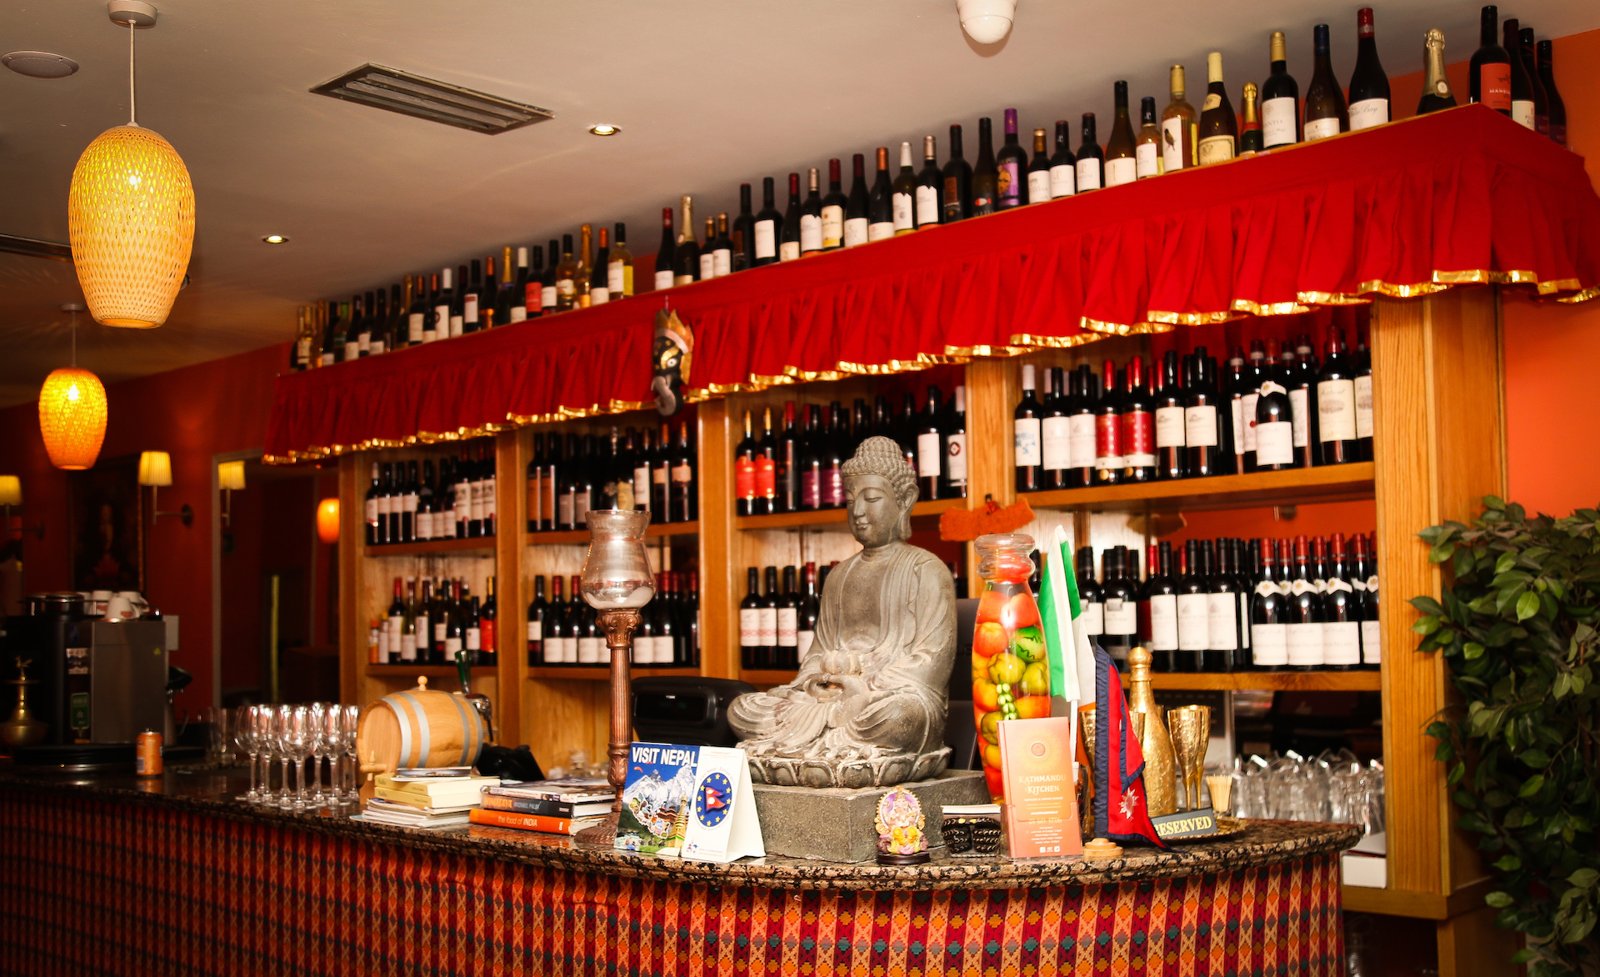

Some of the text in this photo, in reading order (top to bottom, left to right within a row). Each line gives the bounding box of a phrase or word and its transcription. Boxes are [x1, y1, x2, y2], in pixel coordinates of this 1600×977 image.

[632, 747, 698, 767] VISIT NEPAL
[523, 818, 538, 827] INDIA
